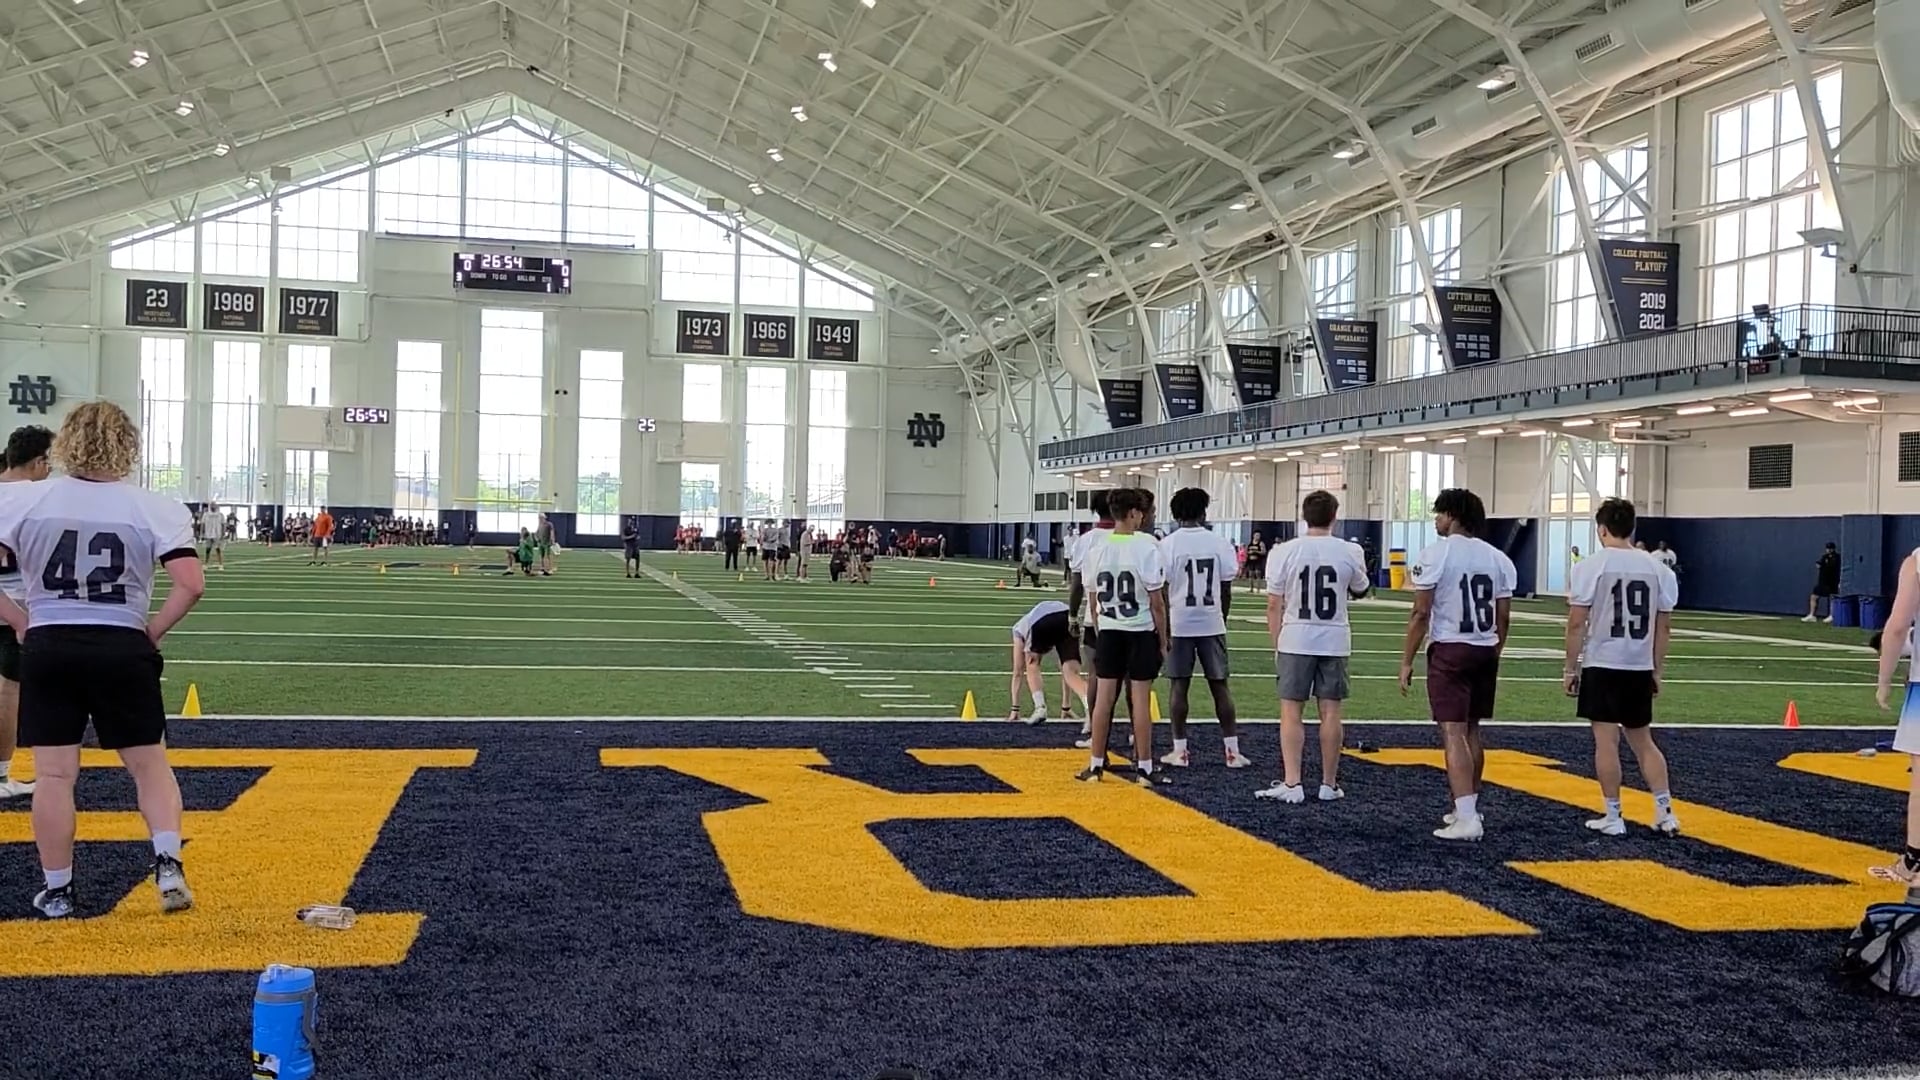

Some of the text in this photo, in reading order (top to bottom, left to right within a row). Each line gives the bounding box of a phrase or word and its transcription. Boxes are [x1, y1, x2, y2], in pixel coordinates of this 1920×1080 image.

[1613, 248, 1668, 260] COLLEGE FOOTBALL
[464, 260, 471, 270] 0
[562, 266, 569, 277] 0
[1635, 261, 1668, 272] PLAYOFF
[146, 288, 169, 308] 23
[213, 292, 255, 313] 1988
[289, 296, 329, 317] 1977
[1447, 292, 1491, 303] COTTON BOWL
[1639, 292, 1666, 310] 2019
[1453, 304, 1492, 313] APPEARANCES
[685, 317, 722, 337] 1973
[752, 321, 788, 340] 1966
[1352, 325, 1369, 334] BOWL
[1639, 313, 1665, 330] 2021
[816, 324, 852, 344] 1949
[1334, 334, 1369, 343] APPEARANCES
[346, 408, 388, 423] 26:54
[638, 418, 656, 432] 25
[42, 529, 126, 604] 42
[1184, 558, 1216, 607] 17
[1096, 570, 1140, 620] 29
[1298, 564, 1338, 621] 16
[1458, 573, 1496, 634] 18
[1610, 578, 1651, 640] 19
